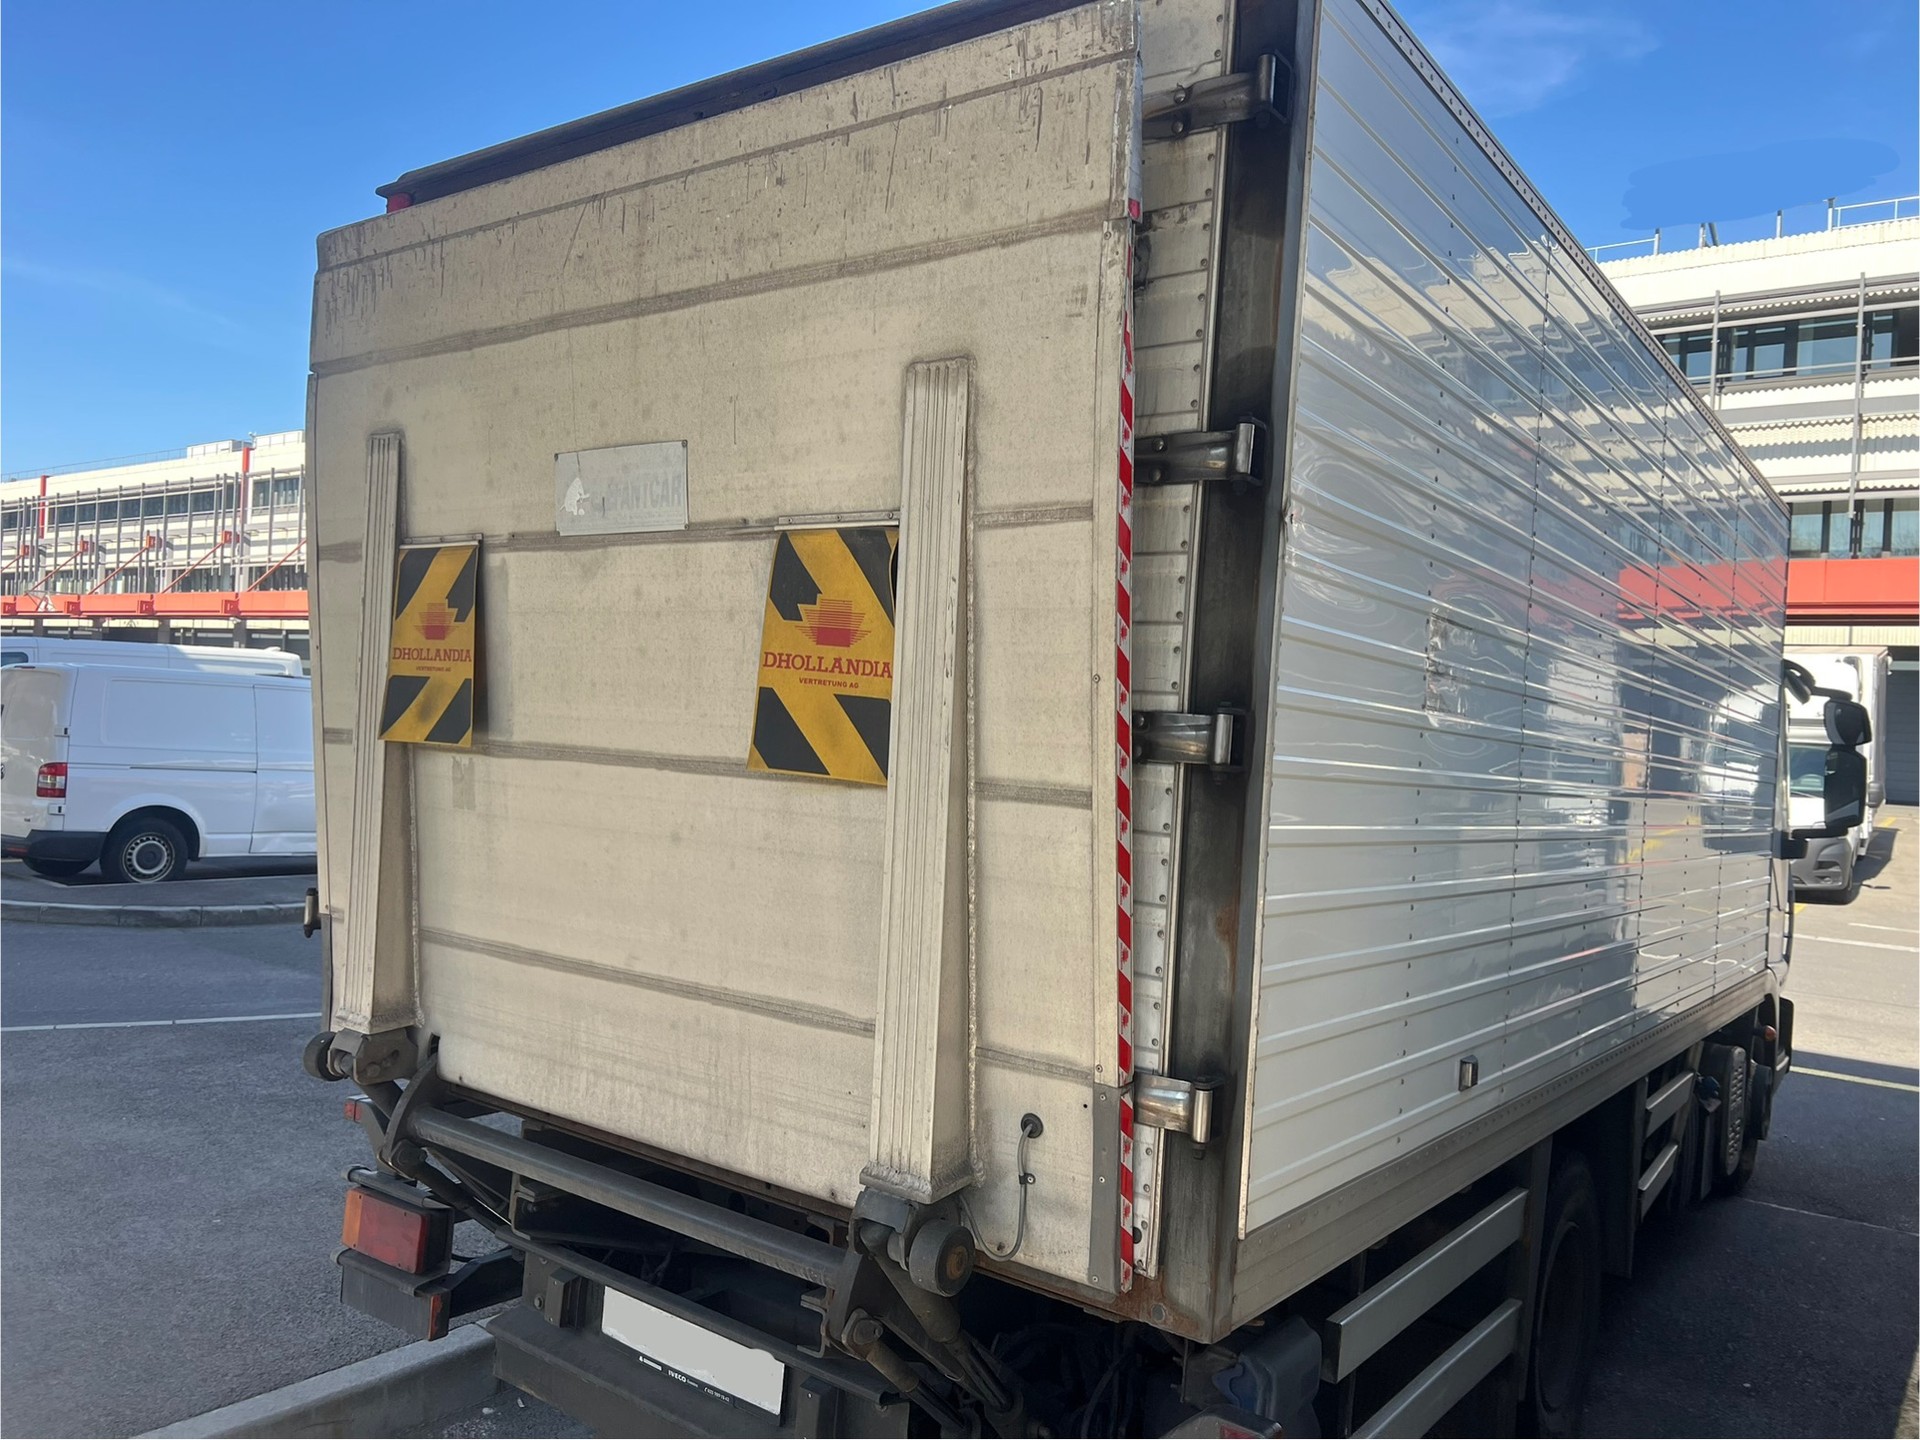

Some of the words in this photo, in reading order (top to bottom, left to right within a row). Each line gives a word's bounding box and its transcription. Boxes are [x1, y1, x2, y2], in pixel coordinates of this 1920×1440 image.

[393, 648, 471, 662] DHOLLANDIA
[763, 652, 893, 679] DHOLLANDIA
[799, 678, 847, 688] VERTRETUNG
[668, 1369, 687, 1383] IVECO
